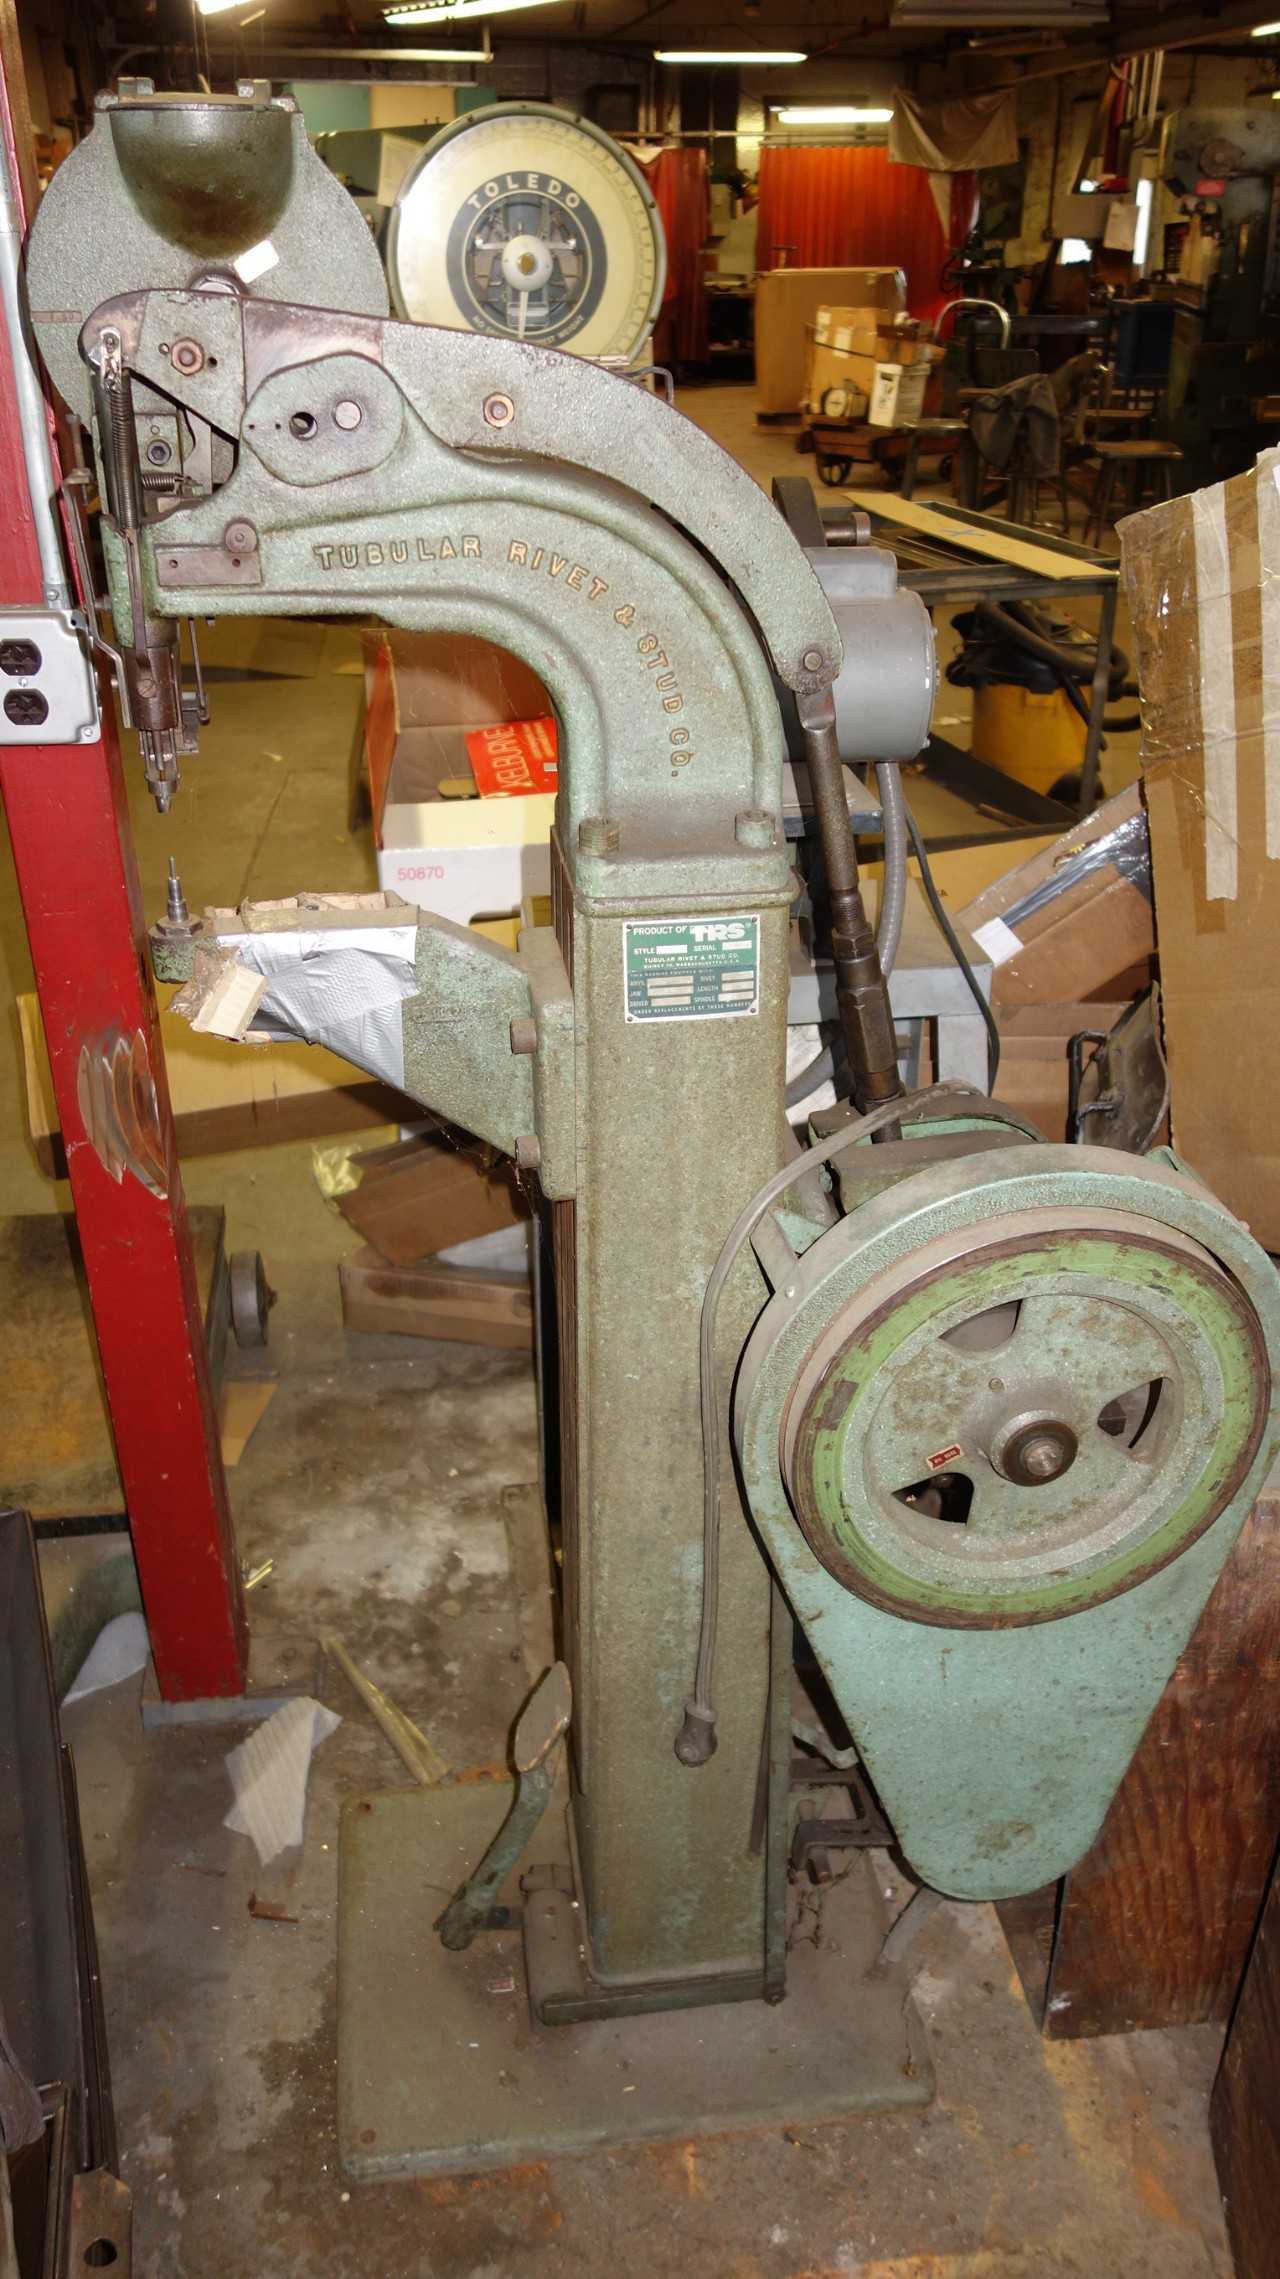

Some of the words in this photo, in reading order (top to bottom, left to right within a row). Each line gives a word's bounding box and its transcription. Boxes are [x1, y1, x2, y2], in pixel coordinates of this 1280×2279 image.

[467, 173, 580, 210] TOLEDO
[313, 534, 482, 571] TUBULAR
[508, 540, 609, 601] RIVET
[613, 604, 636, 629] &
[636, 633, 684, 714] STUD
[669, 727, 694, 778] CO.
[633, 926, 673, 936] PRODUCT
[675, 925, 687, 934] OF
[633, 947, 655, 955] STYLE
[693, 944, 717, 952] SERIAL
[644, 956, 676, 964] TUBULAR
